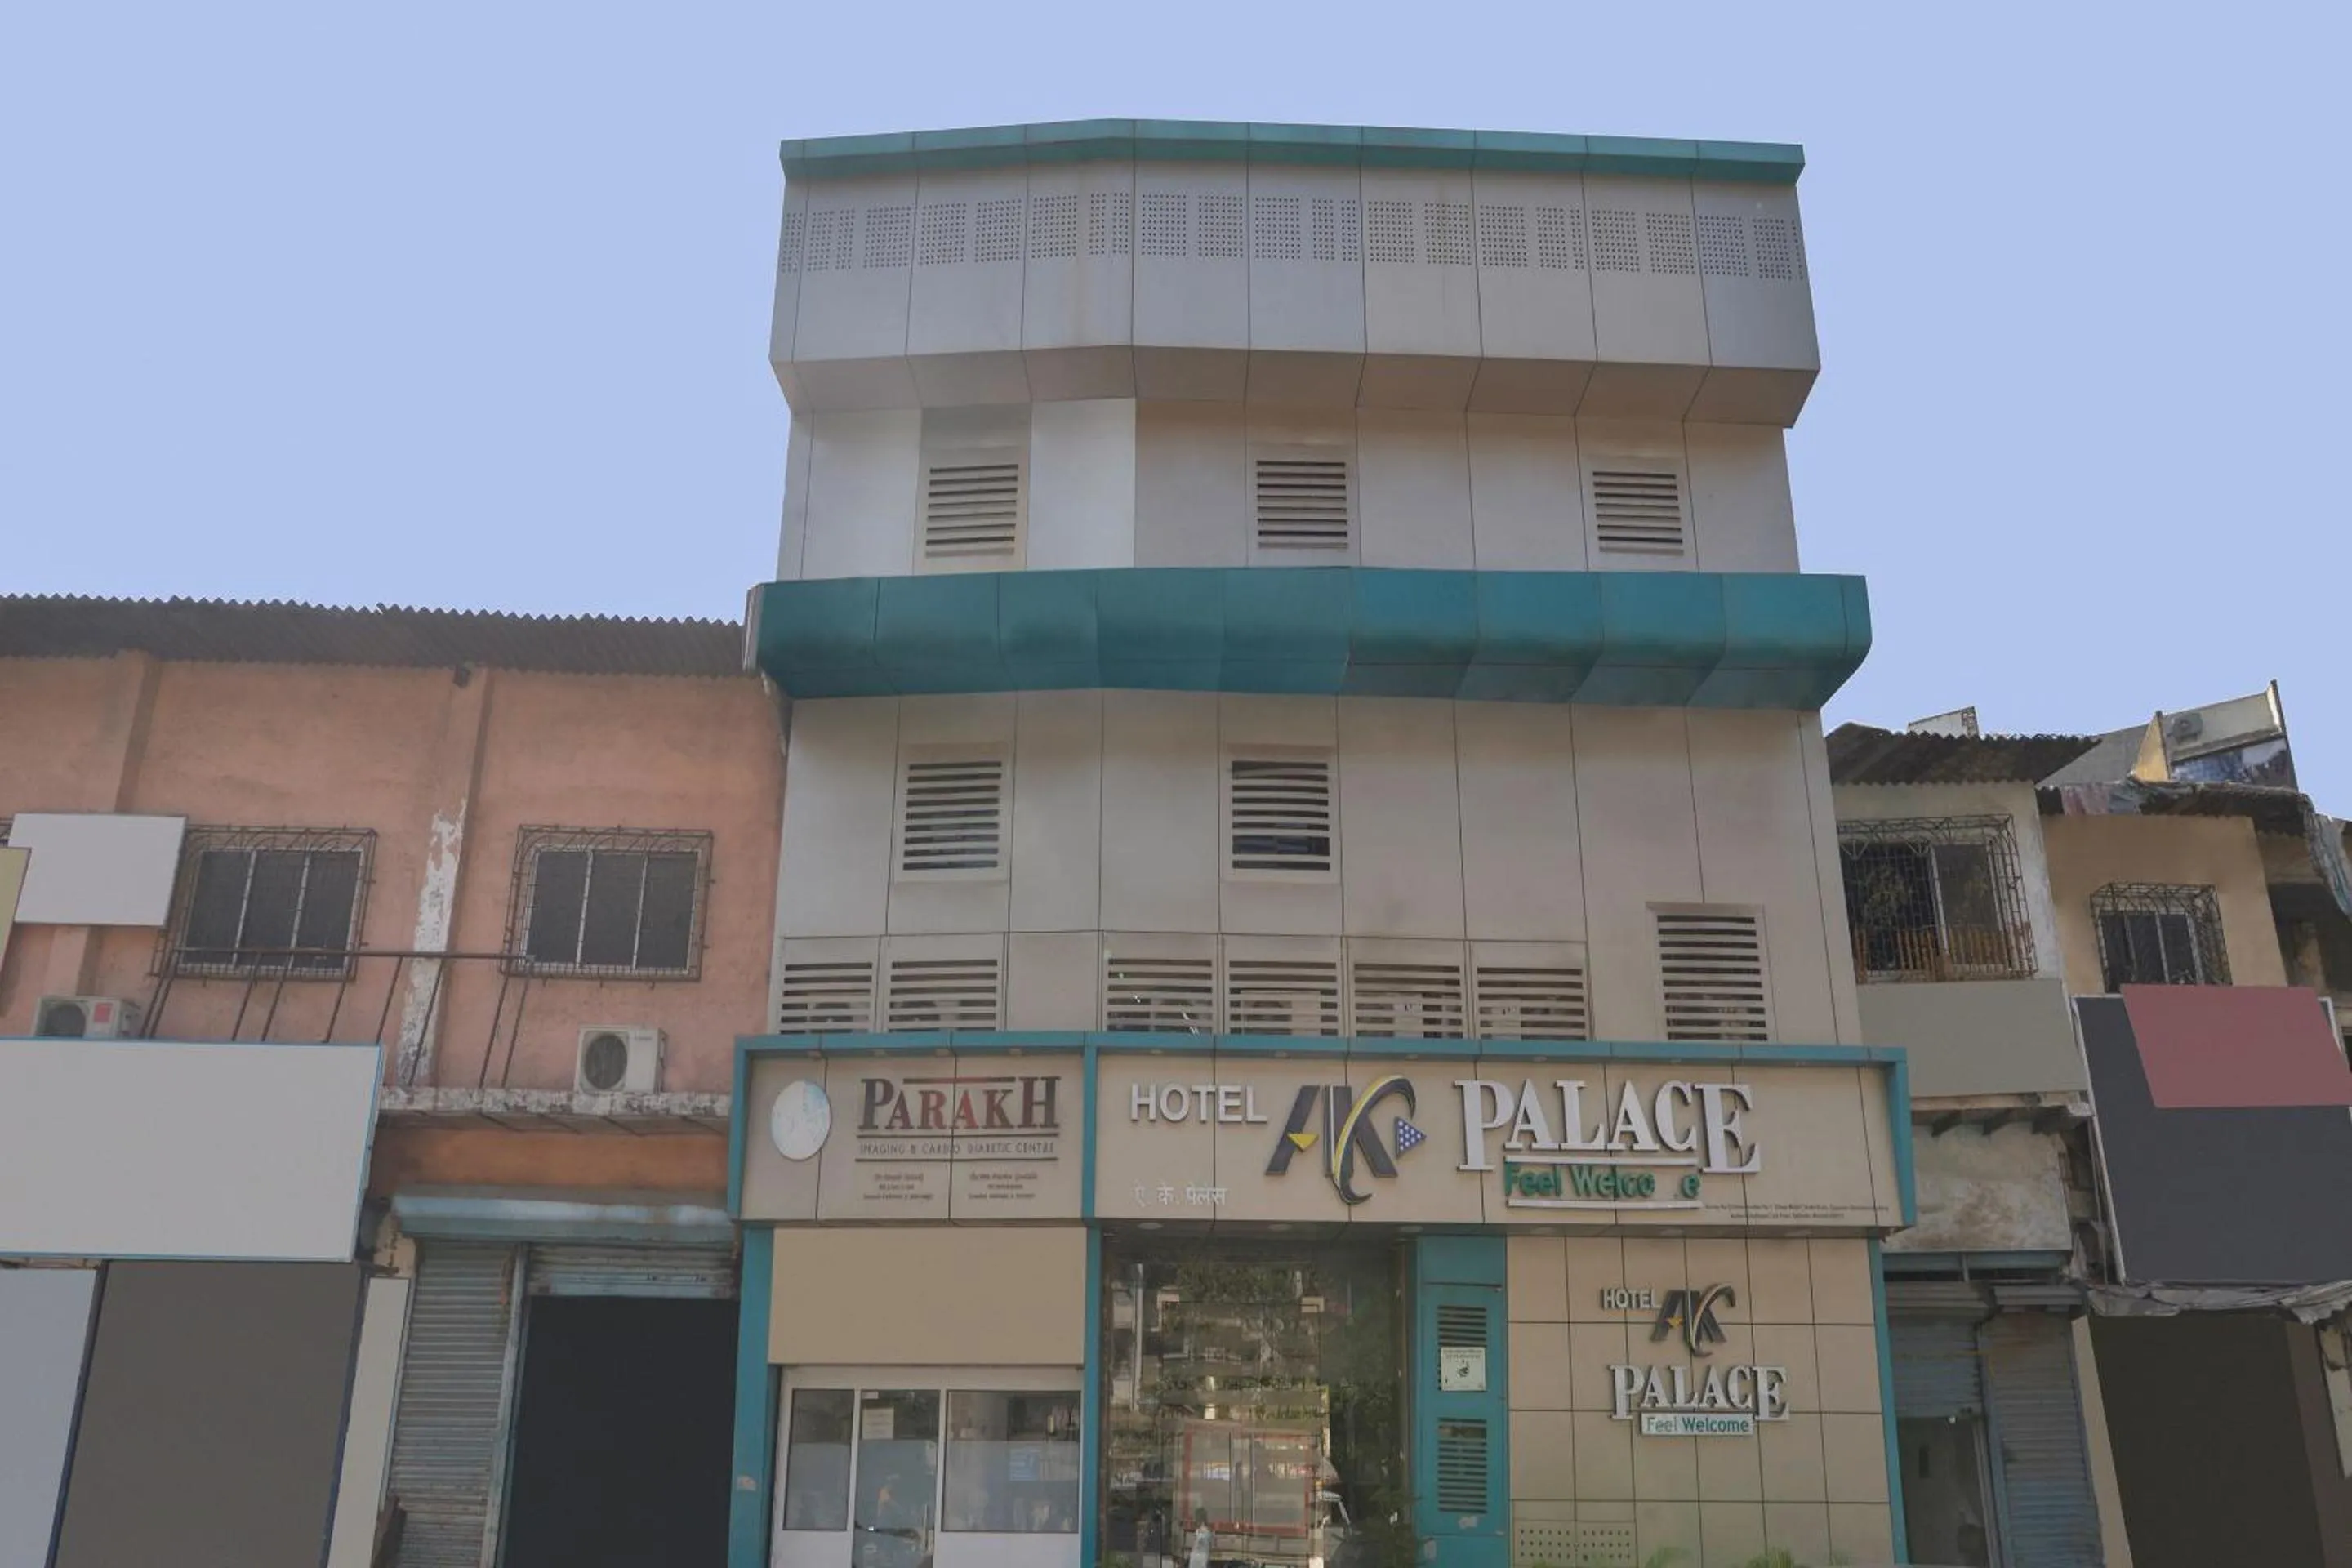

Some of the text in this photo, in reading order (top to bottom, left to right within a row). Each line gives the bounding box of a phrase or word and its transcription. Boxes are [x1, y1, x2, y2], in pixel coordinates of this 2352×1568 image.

[858, 1076, 1061, 1131] PARAKH
[1129, 1083, 1268, 1125] HOTEL
[1454, 1078, 1761, 1174] PALACE
[1505, 1161, 1562, 1198] Feel
[1601, 1288, 1662, 1311] HOTEL
[1607, 1365, 1789, 1421] PALACE
[1646, 1416, 1750, 1434] Feel Welcome
